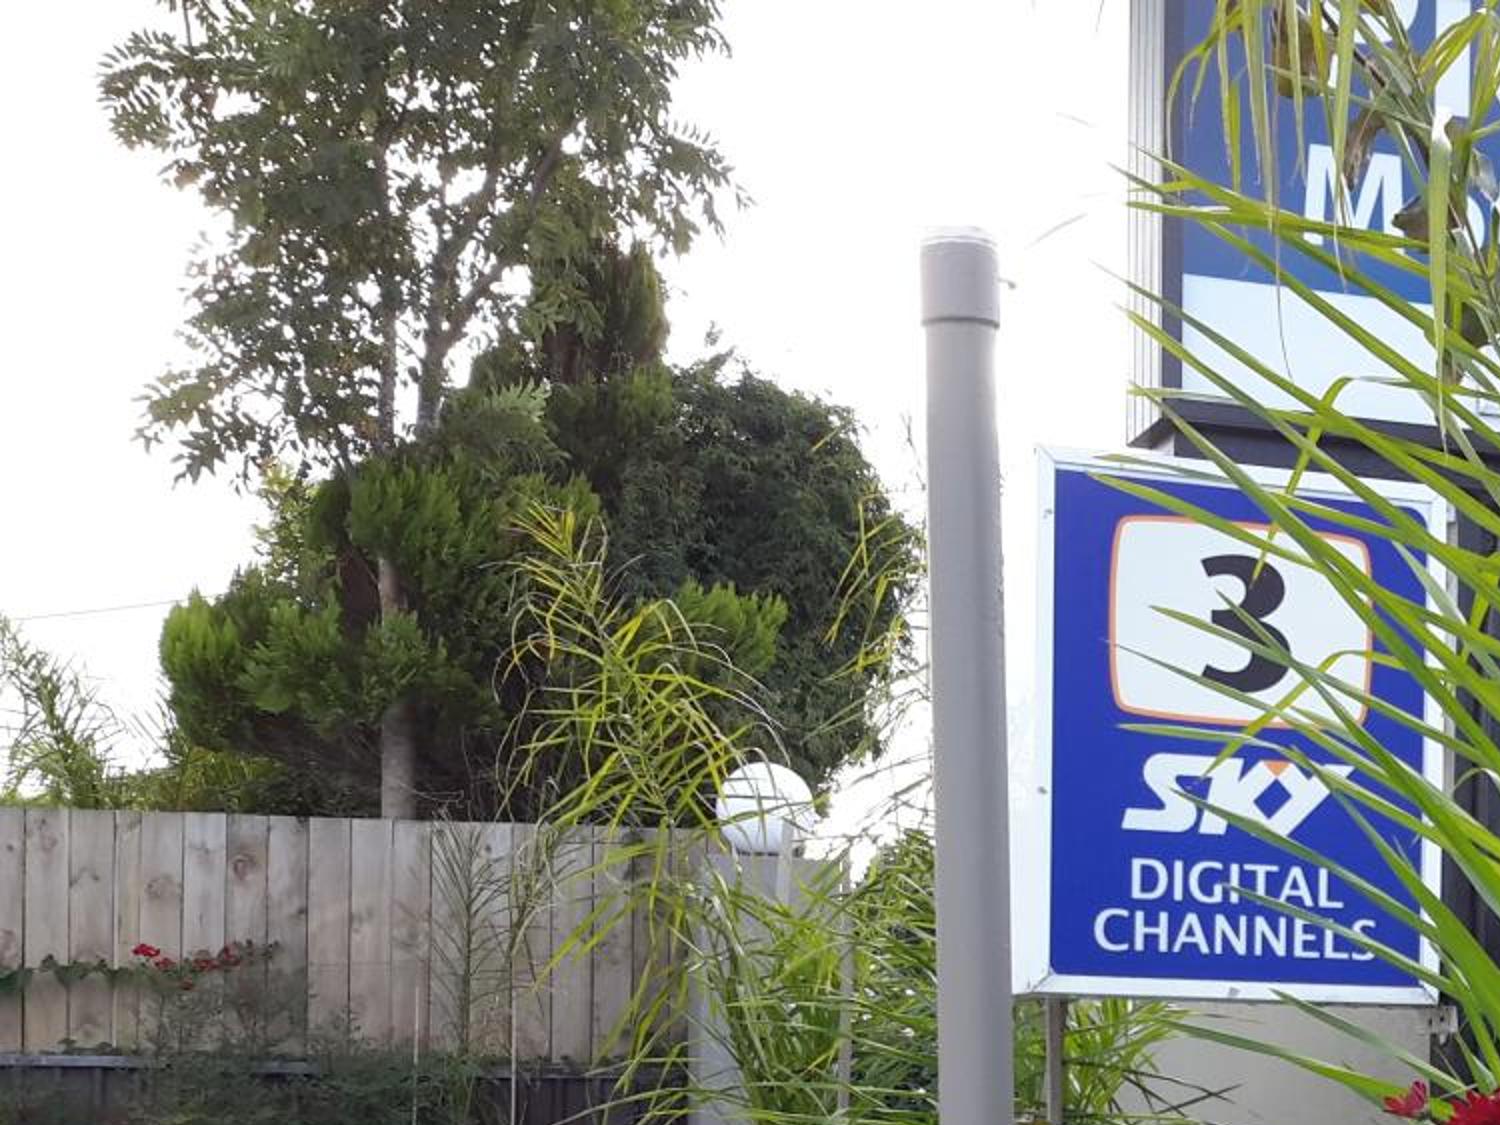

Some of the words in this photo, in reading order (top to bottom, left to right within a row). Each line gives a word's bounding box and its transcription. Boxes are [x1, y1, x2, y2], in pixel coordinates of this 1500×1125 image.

[1201, 553, 1291, 694] 3
[1121, 752, 1356, 836] SKY
[1130, 856, 1345, 910] DIGITAL
[1093, 907, 1378, 962] CHANNELS
